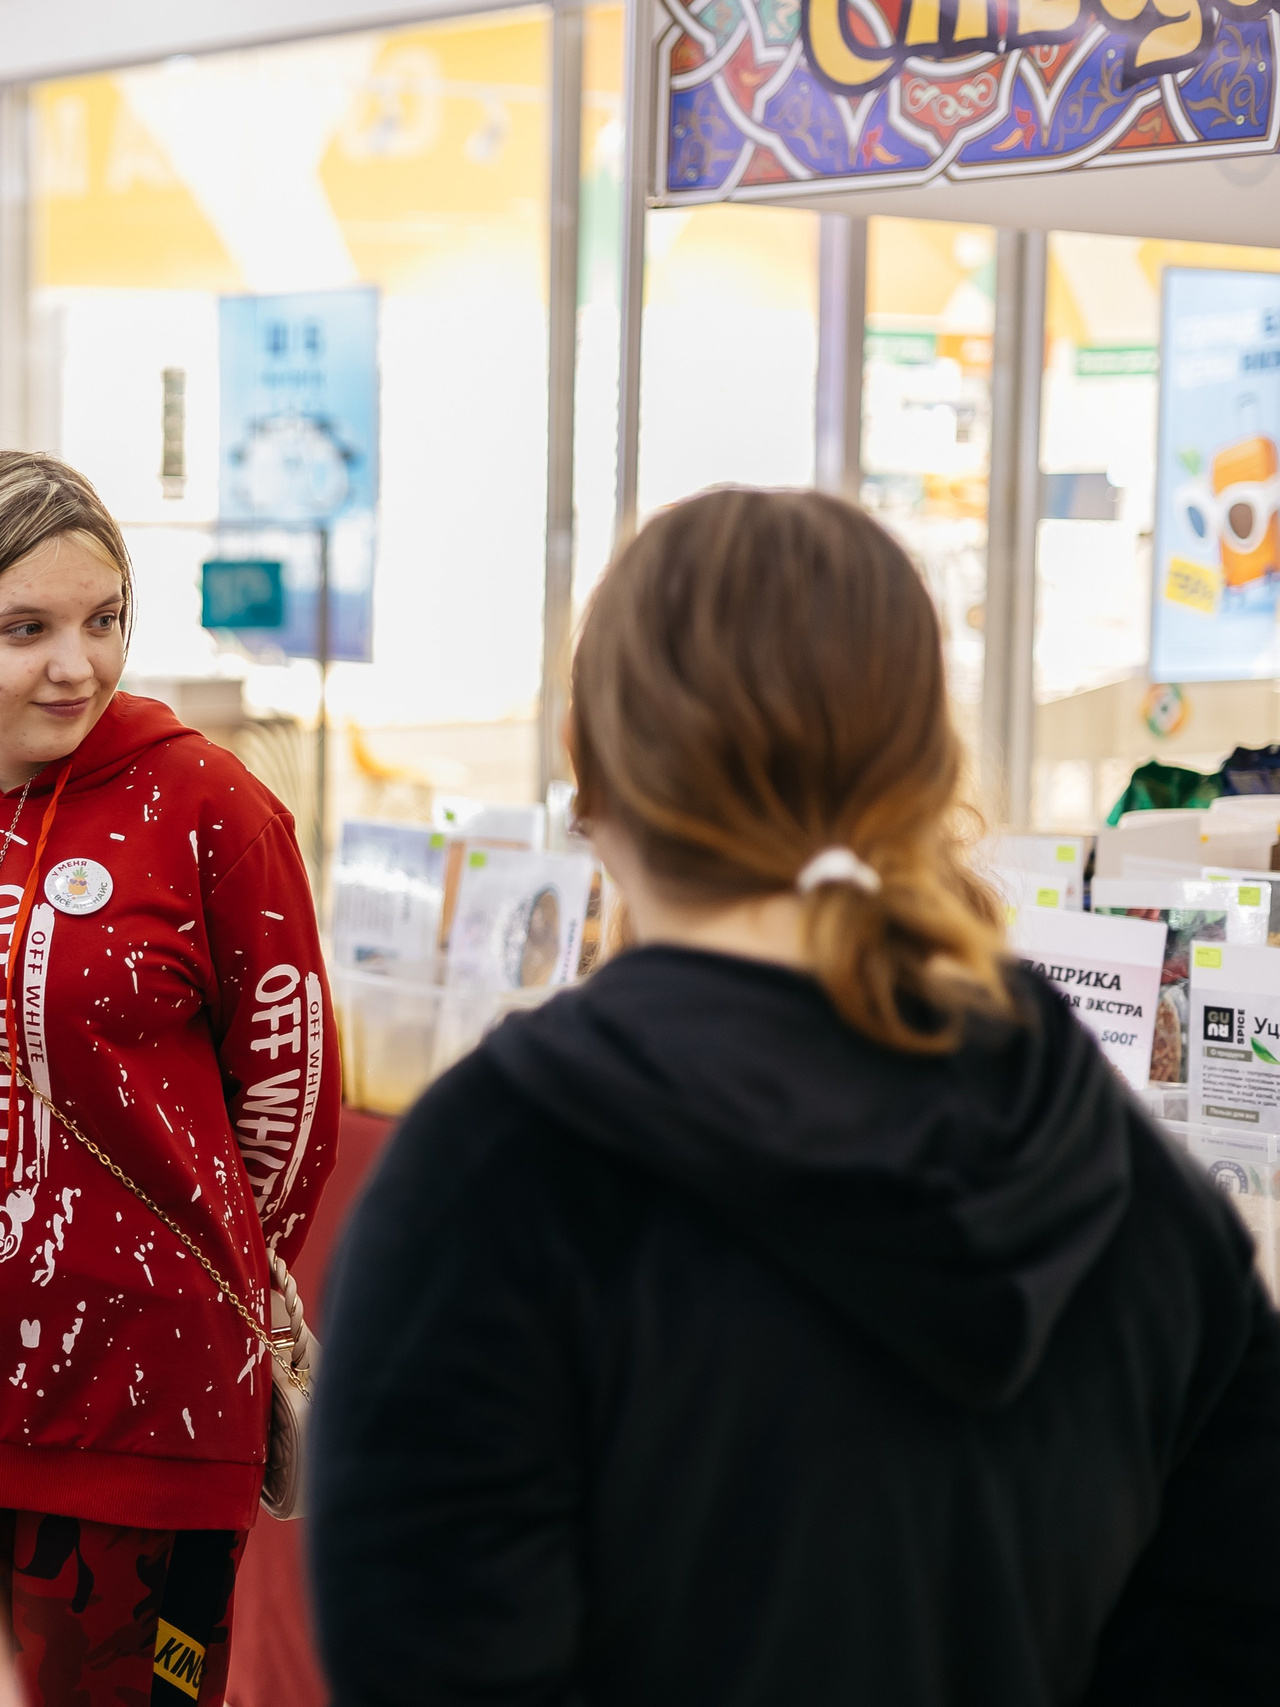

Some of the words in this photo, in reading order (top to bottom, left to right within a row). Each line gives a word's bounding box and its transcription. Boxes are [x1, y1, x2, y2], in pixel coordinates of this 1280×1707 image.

[58, 860, 87, 871] МЕНЯ
[28, 930, 46, 976] OFF
[26, 985, 45, 1064] WHITE
[250, 963, 302, 1060] OFF
[308, 1001, 320, 1041] OFF
[1086, 997, 1143, 1017] ЭКСТРА
[1237, 1009, 1245, 1044] SPICE
[303, 1050, 320, 1123] WHITE
[235, 1068, 301, 1215] WHIT
